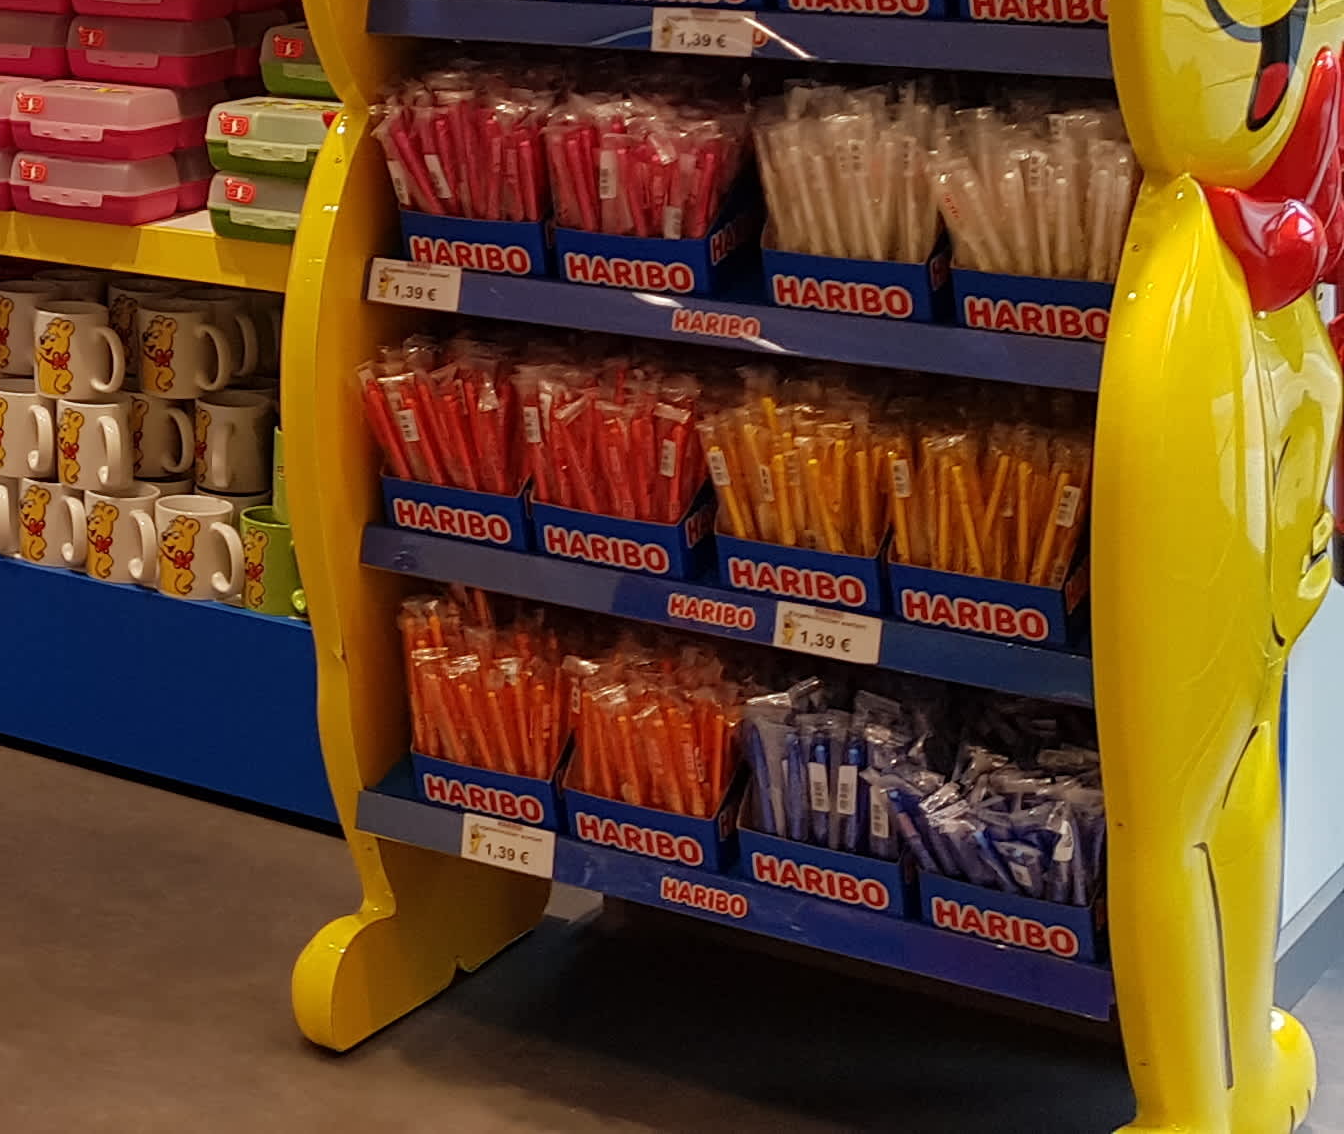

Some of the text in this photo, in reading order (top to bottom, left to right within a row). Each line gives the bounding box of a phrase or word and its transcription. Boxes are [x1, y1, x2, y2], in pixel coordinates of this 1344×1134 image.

[676, 32, 727, 49] 1,39 €
[409, 236, 531, 276] HARIBO
[564, 252, 695, 293] HARIBO
[393, 284, 438, 302] 1,39 €
[772, 274, 913, 319] HARIBO
[672, 308, 760, 339] HARIBO
[965, 295, 1111, 342] HARIBO
[393, 498, 512, 543] HARIBO
[544, 526, 670, 575] HARIBO
[728, 556, 866, 607] HARIBO
[668, 592, 755, 630] HARIBO
[901, 589, 1048, 641] HARIBO
[800, 630, 852, 654] 1,39 €
[423, 773, 544, 823] HARIBO
[485, 842, 530, 865] 1,39 €
[576, 813, 703, 865] HARIBO
[661, 876, 748, 918] HARIBO
[752, 851, 890, 910] HARIBO
[931, 896, 1079, 957] HARIBO
